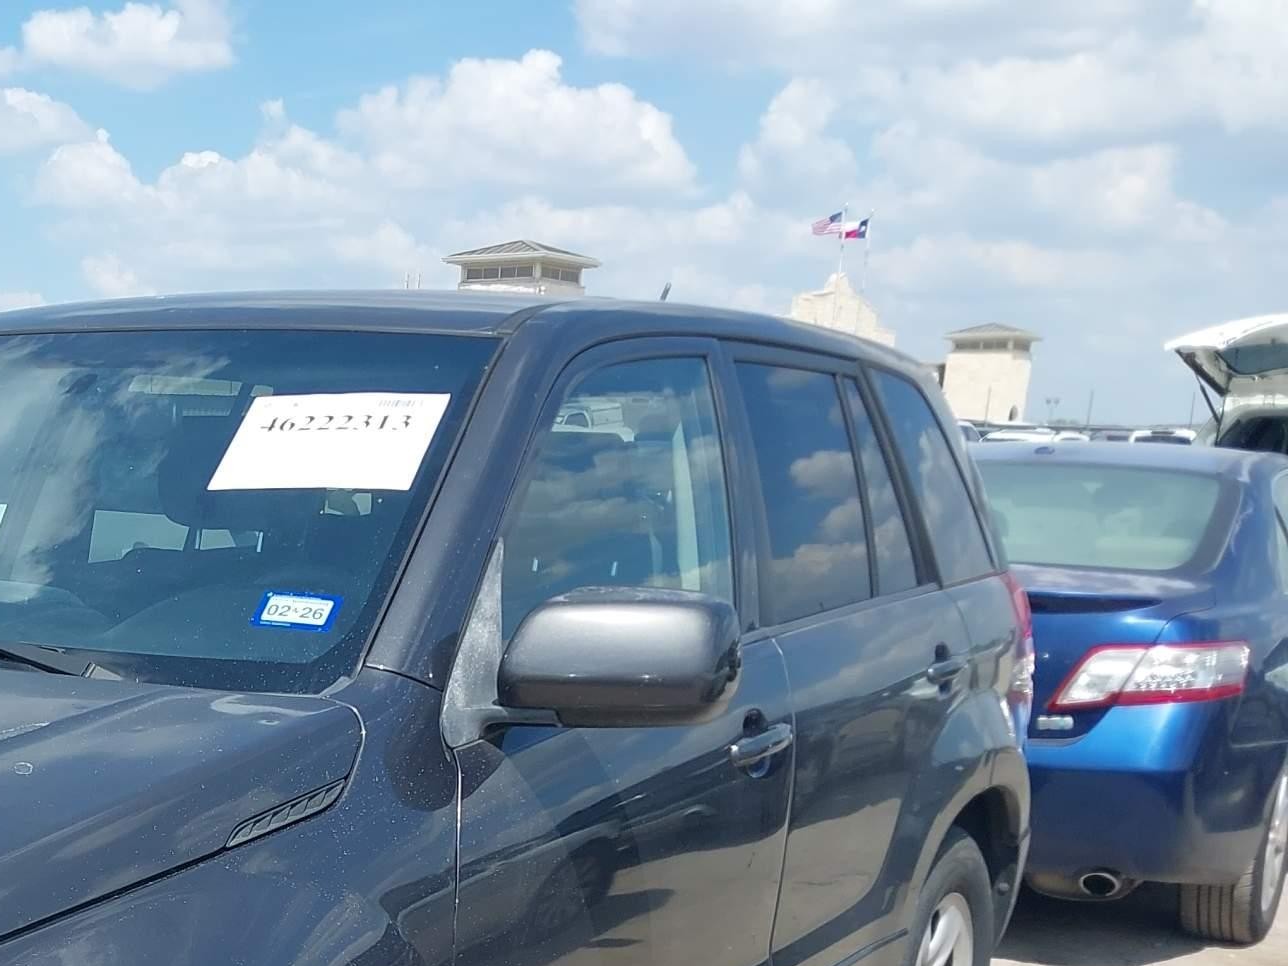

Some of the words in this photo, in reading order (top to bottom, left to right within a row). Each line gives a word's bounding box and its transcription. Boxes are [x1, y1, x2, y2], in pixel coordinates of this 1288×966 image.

[260, 414, 412, 432] 46222313
[266, 604, 291, 617] 02
[298, 606, 325, 620] 26
